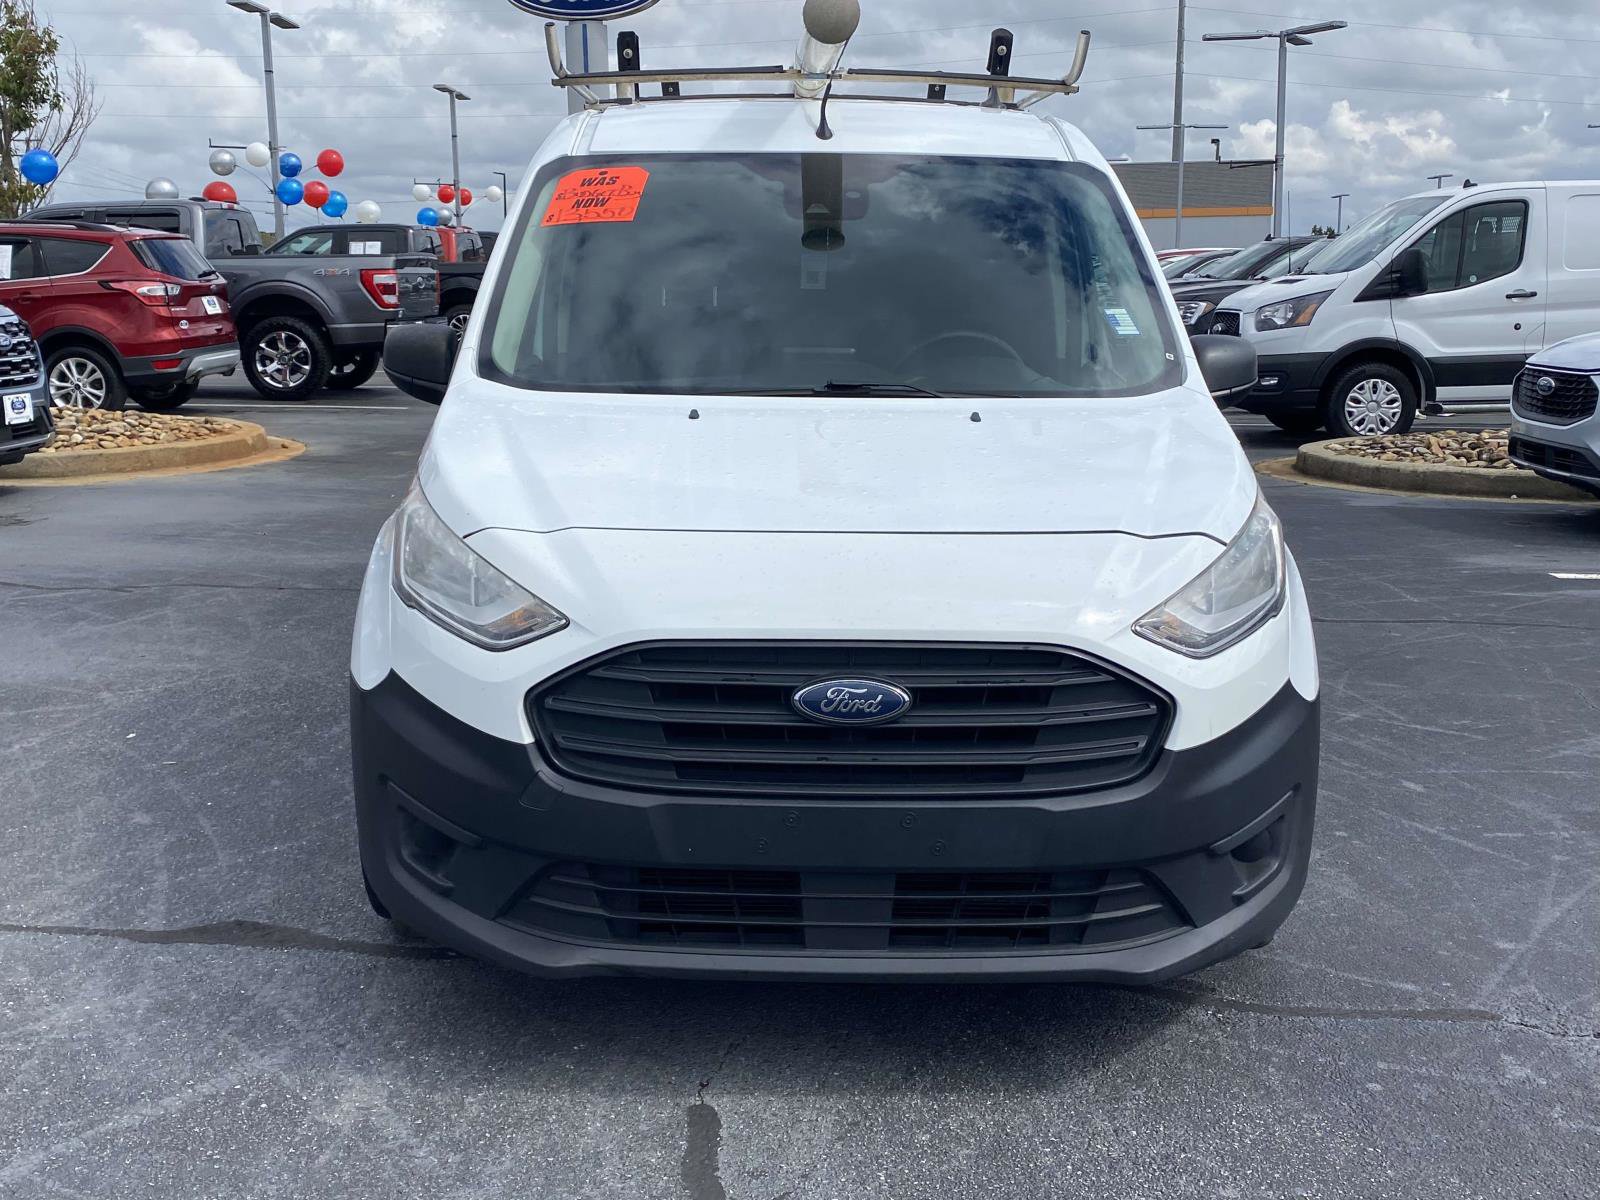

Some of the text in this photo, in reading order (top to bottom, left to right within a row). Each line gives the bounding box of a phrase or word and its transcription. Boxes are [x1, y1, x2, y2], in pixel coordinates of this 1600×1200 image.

[580, 176, 620, 187] WAS
[571, 197, 611, 209] NOW
[820, 686, 883, 712] Ford
